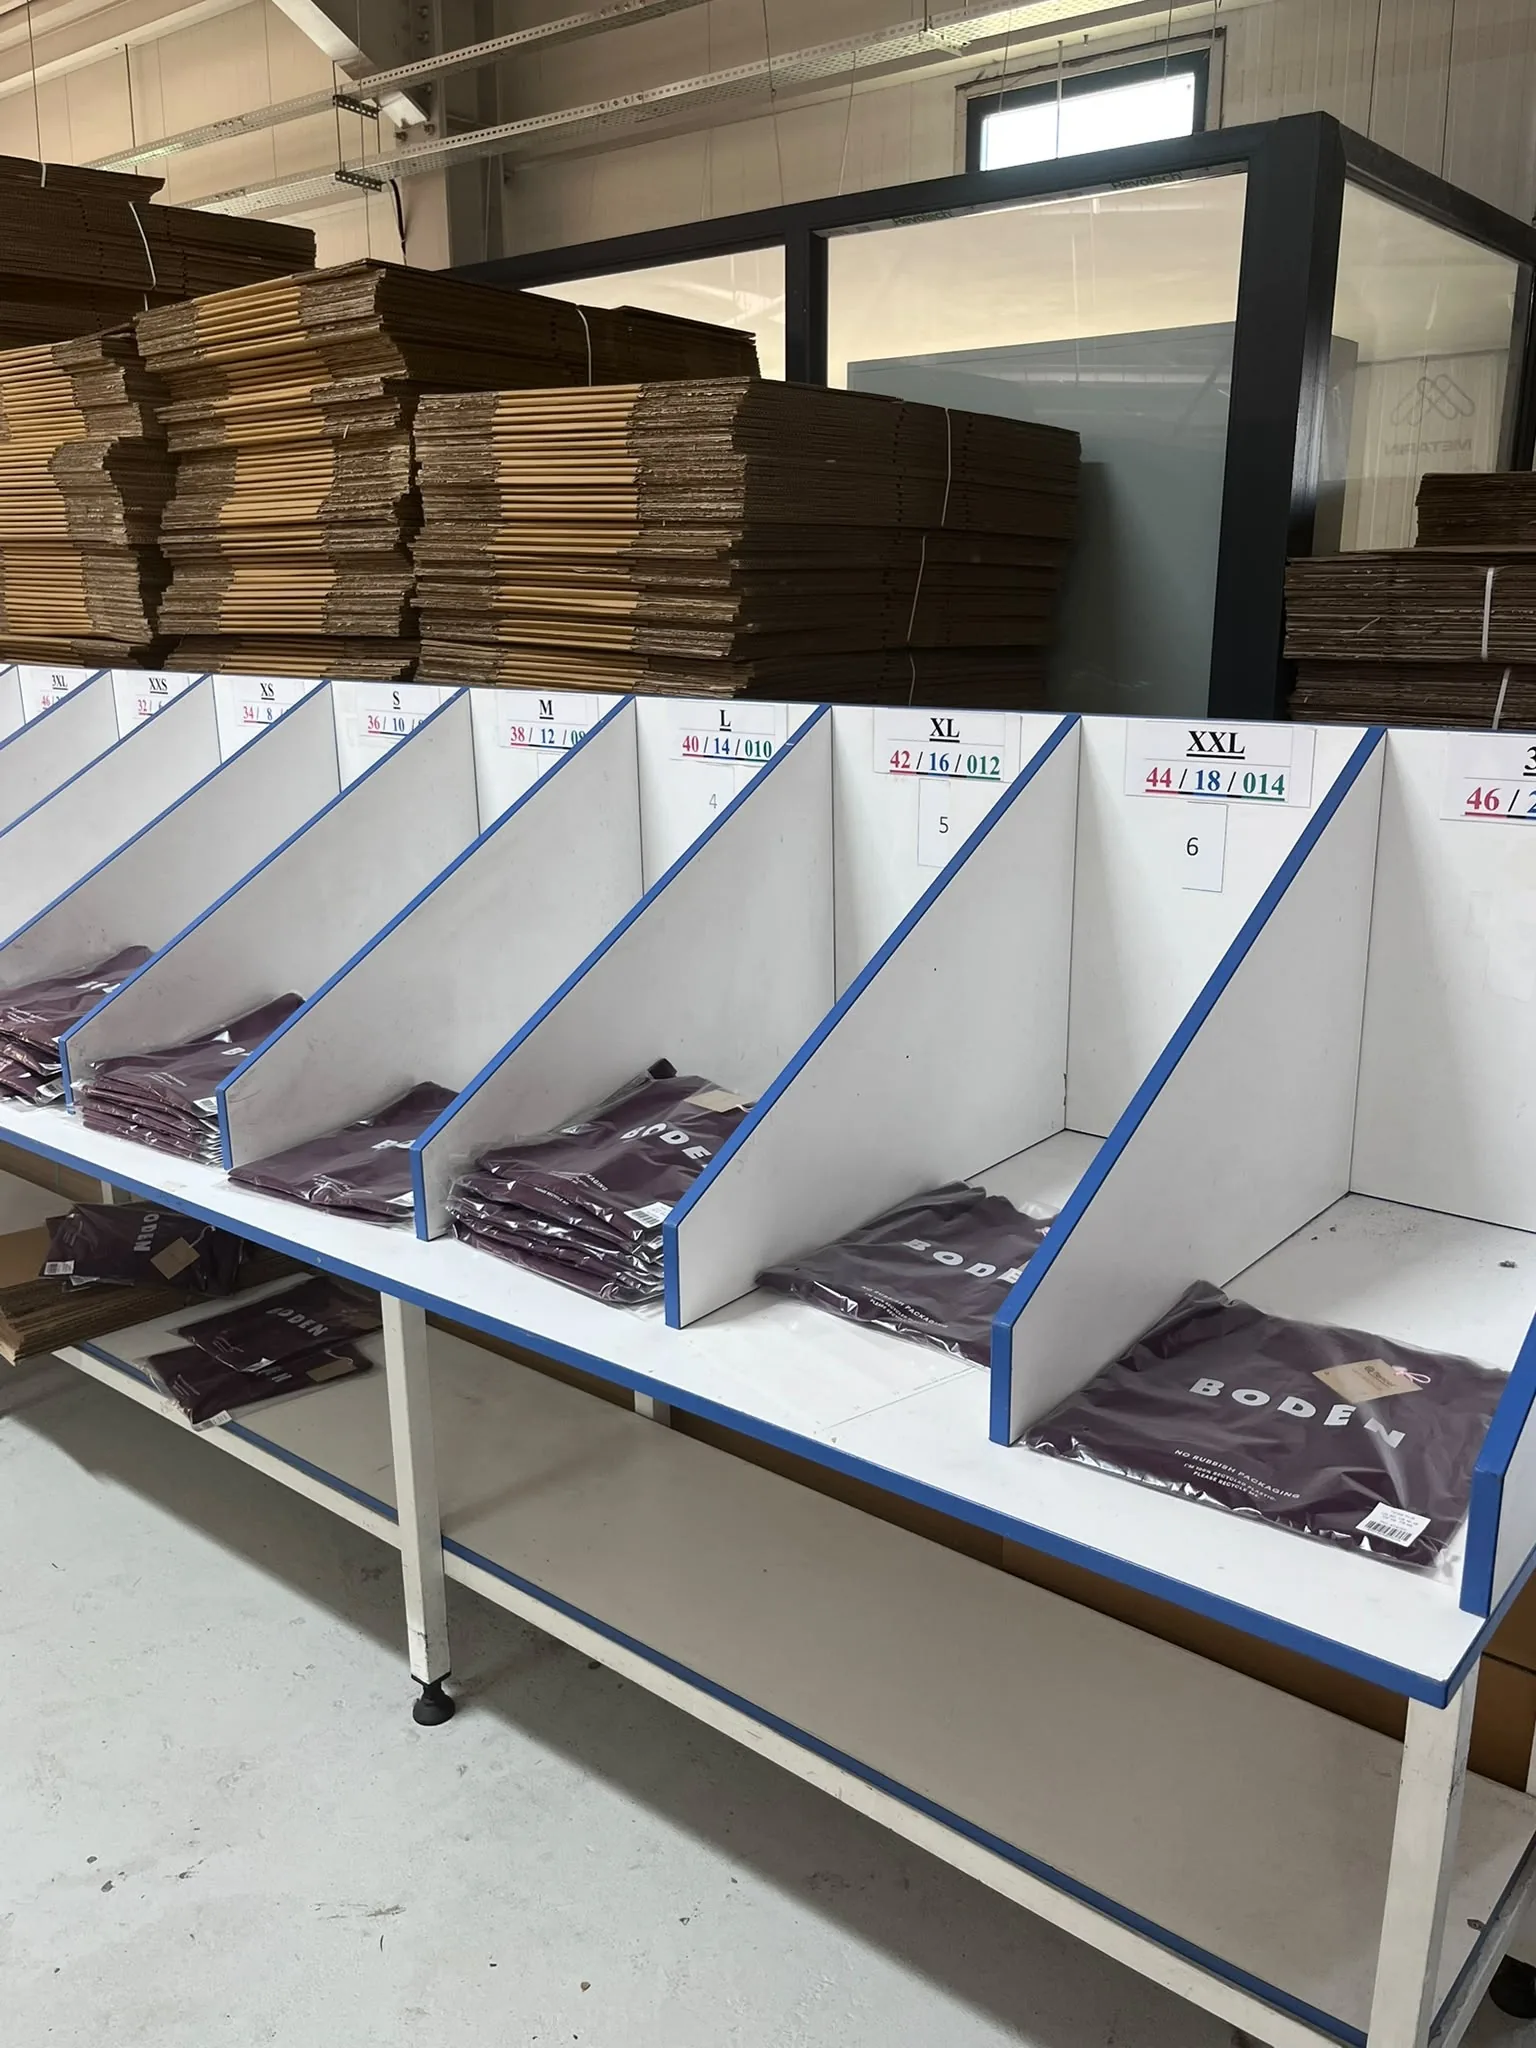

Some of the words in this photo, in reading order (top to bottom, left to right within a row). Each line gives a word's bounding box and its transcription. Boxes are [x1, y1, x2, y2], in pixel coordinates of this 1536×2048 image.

[52, 675, 68, 687] 3XL
[149, 677, 168, 691] XXS
[260, 683, 275, 697] XS
[393, 691, 400, 705] S
[539, 700, 553, 716] M
[368, 715, 380, 730] 36
[720, 709, 731, 727] L
[511, 726, 525, 742] 38
[541, 728, 555, 744] 12
[930, 718, 960, 738] XL
[682, 735, 699, 752] 40
[714, 737, 730, 755] 14
[744, 740, 772, 758] 010
[1187, 730, 1246, 754] XXL
[890, 750, 911, 769] 42
[929, 752, 949, 772] 16
[967, 755, 1000, 775] 012
[1146, 767, 1172, 788] 44
[1195, 769, 1221, 791] 18
[1243, 772, 1285, 796] 014
[709, 793, 717, 809] 4
[1466, 786, 1500, 812] 46
[939, 816, 949, 834] 5
[1186, 837, 1199, 856] 6
[620, 1122, 712, 1169] BODE
[133, 1213, 160, 1252] ODEN
[901, 1238, 1023, 1284] BODE
[1189, 1377, 1406, 1449] BODEN
[1174, 1449, 1191, 1458] NO
[1192, 1455, 1236, 1473] RUBBISH
[1238, 1471, 1300, 1499] PACKAGING
[1193, 1471, 1217, 1482] PLEASE
